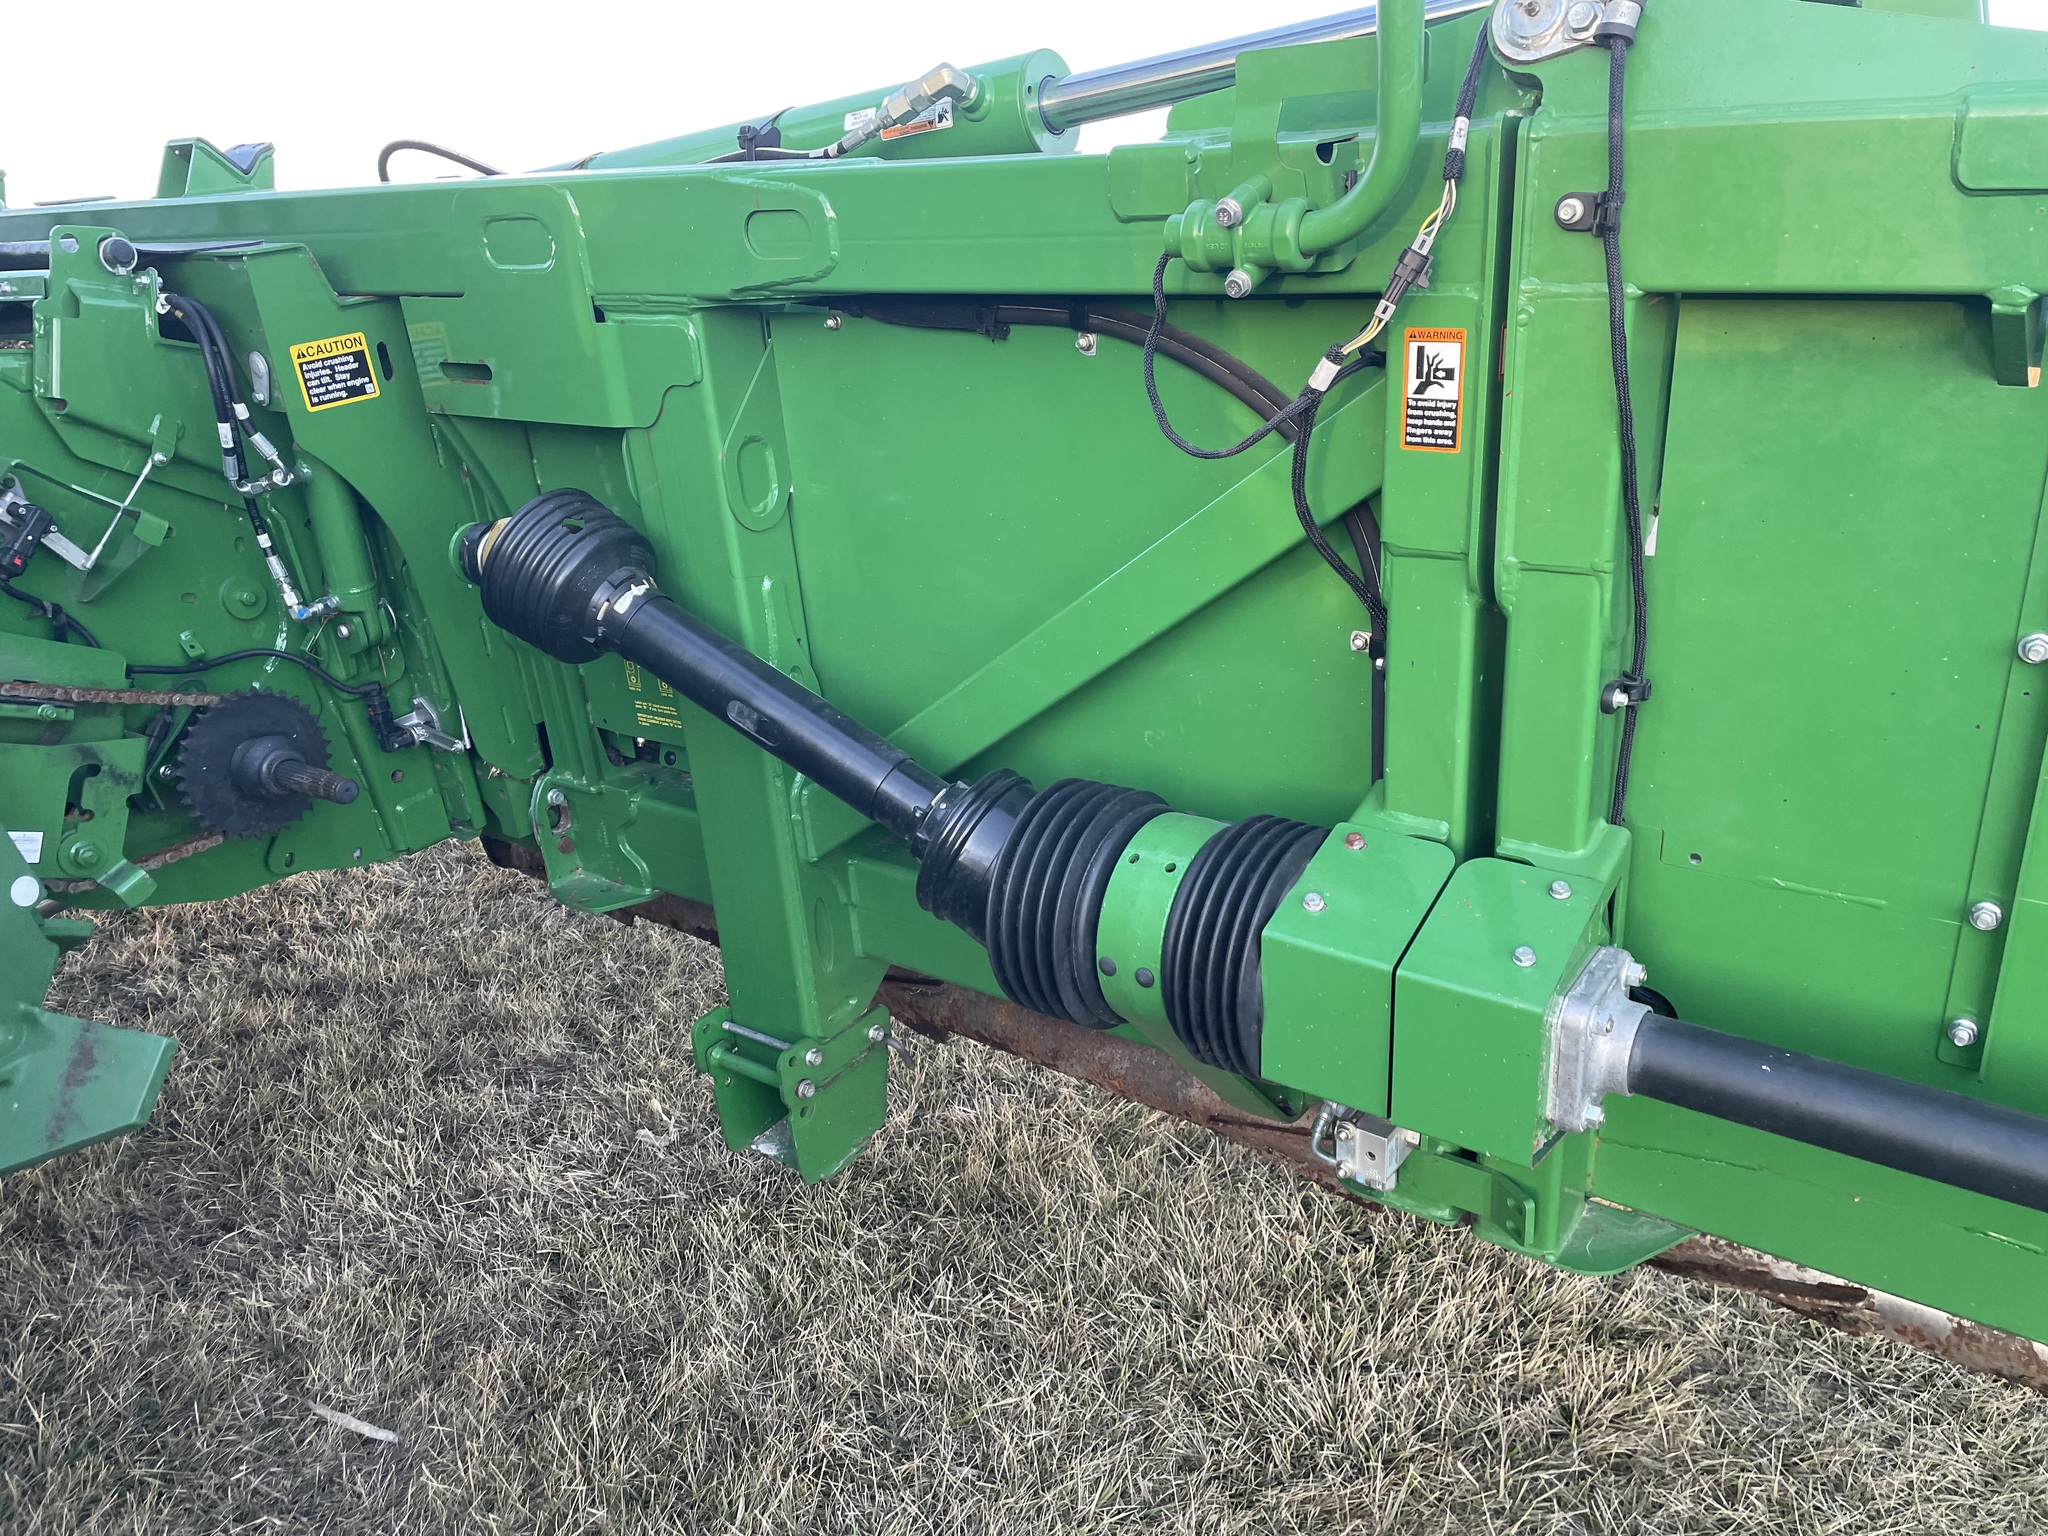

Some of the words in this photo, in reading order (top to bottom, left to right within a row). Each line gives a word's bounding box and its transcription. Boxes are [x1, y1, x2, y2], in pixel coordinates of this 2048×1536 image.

[1417, 331, 1463, 340] WARNING
[306, 336, 363, 357] CAUTION
[302, 360, 323, 371] Avoid
[323, 355, 354, 366] crushing
[334, 362, 359, 372] Header
[307, 379, 320, 387] can
[321, 377, 332, 385] tilt.
[334, 372, 350, 381] Stay
[309, 386, 326, 395] clear
[327, 381, 346, 391] when
[346, 376, 369, 387] engine
[319, 390, 348, 401] running.
[1436, 400, 1457, 410] injury
[1407, 408, 1423, 416] from
[1424, 409, 1456, 419] crushing,
[1406, 417, 1423, 426] keep
[1423, 418, 1443, 426] hands
[1406, 426, 1432, 435] fingers
[1433, 429, 1453, 437] away
[1406, 435, 1422, 443] from
[1422, 436, 1436, 444] this
